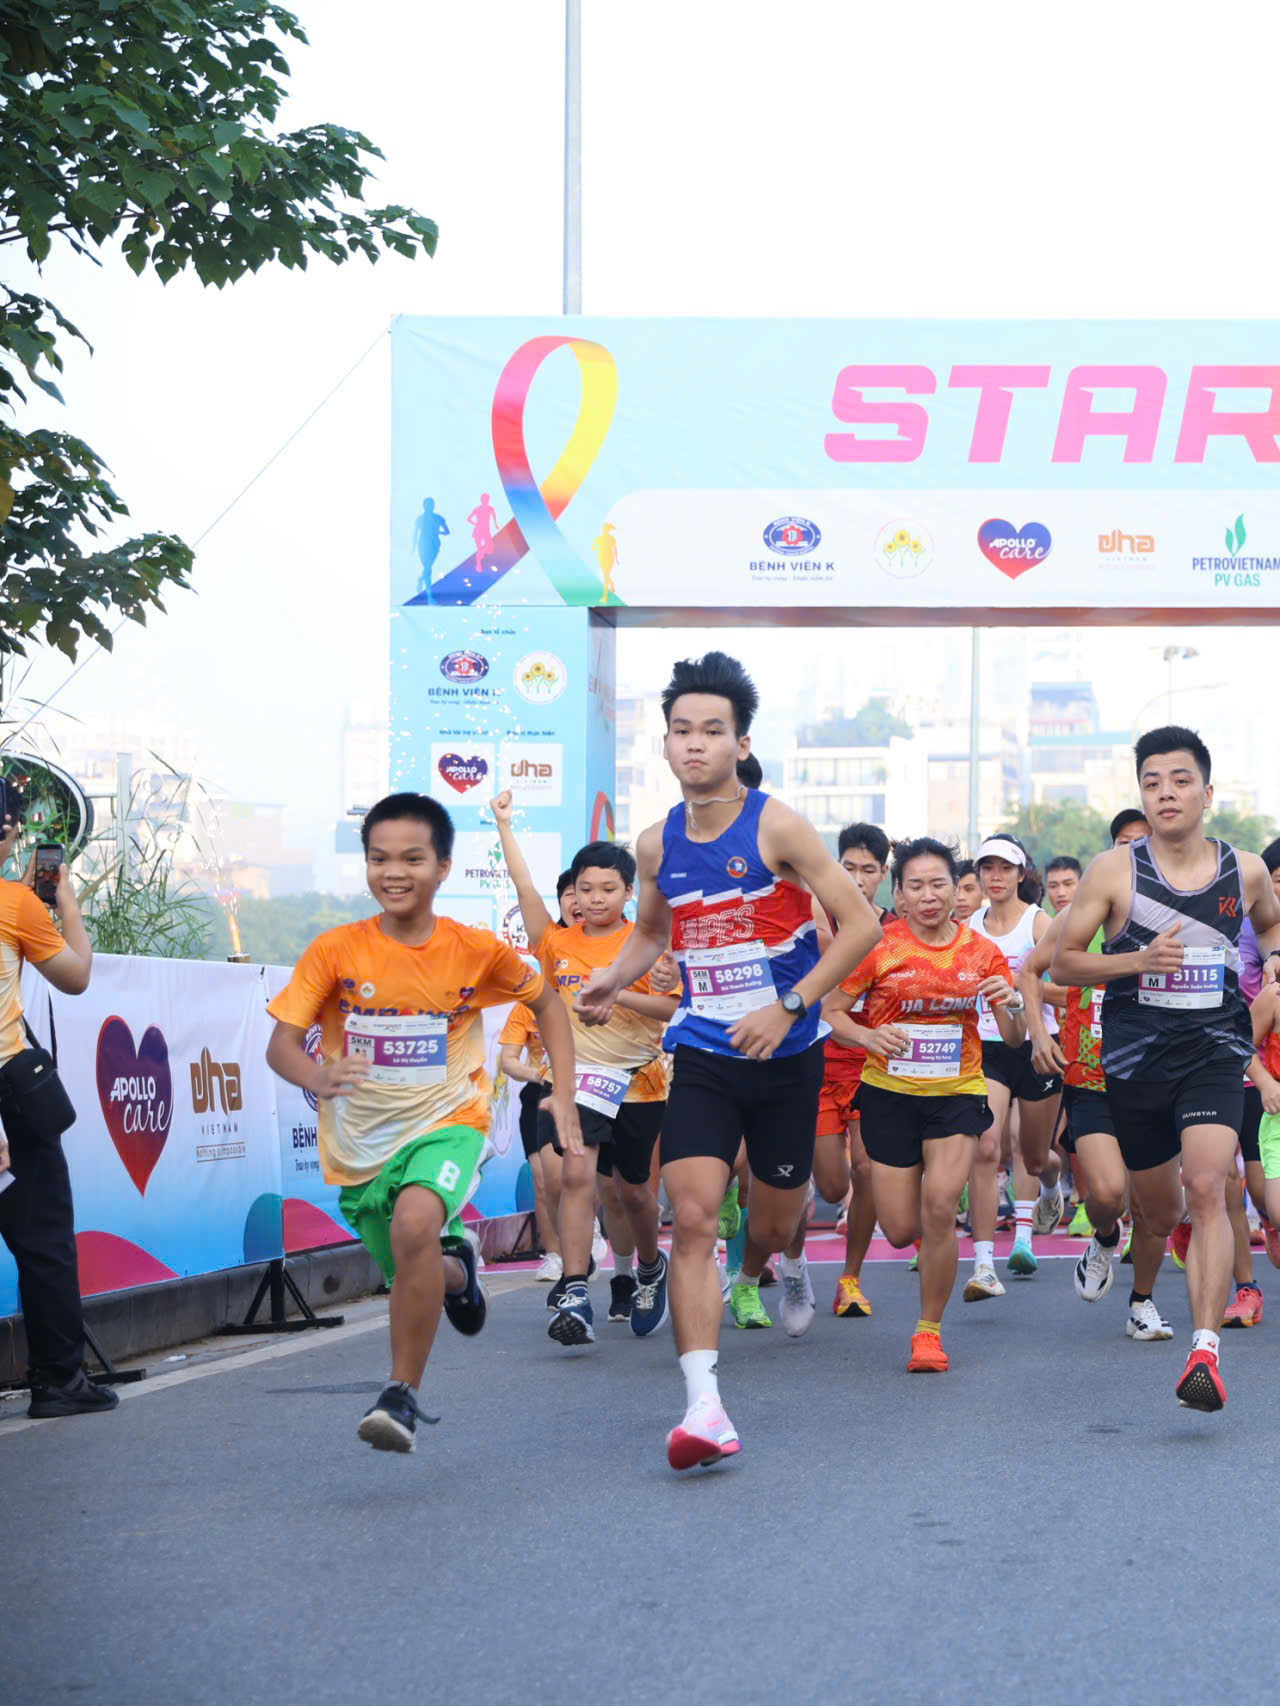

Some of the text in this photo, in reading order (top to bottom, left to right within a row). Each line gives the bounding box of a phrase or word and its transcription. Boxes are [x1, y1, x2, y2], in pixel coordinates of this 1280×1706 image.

[989, 537, 1036, 549] APOLLO
[1000, 547, 1049, 560] care
[825, 561, 835, 571] K
[1214, 573, 1261, 587] PV GAS
[715, 963, 763, 984] 58298
[1173, 968, 1218, 982] 51115
[698, 981, 708, 992] M
[1148, 977, 1159, 988] M
[351, 1036, 372, 1046] 5KM
[383, 1039, 439, 1055] 53725
[919, 1042, 956, 1054] 52749
[110, 1076, 157, 1102] APOLLO
[587, 1076, 622, 1095] 58757
[123, 1100, 170, 1134] care
[201, 1122, 239, 1135] VIETNAM
